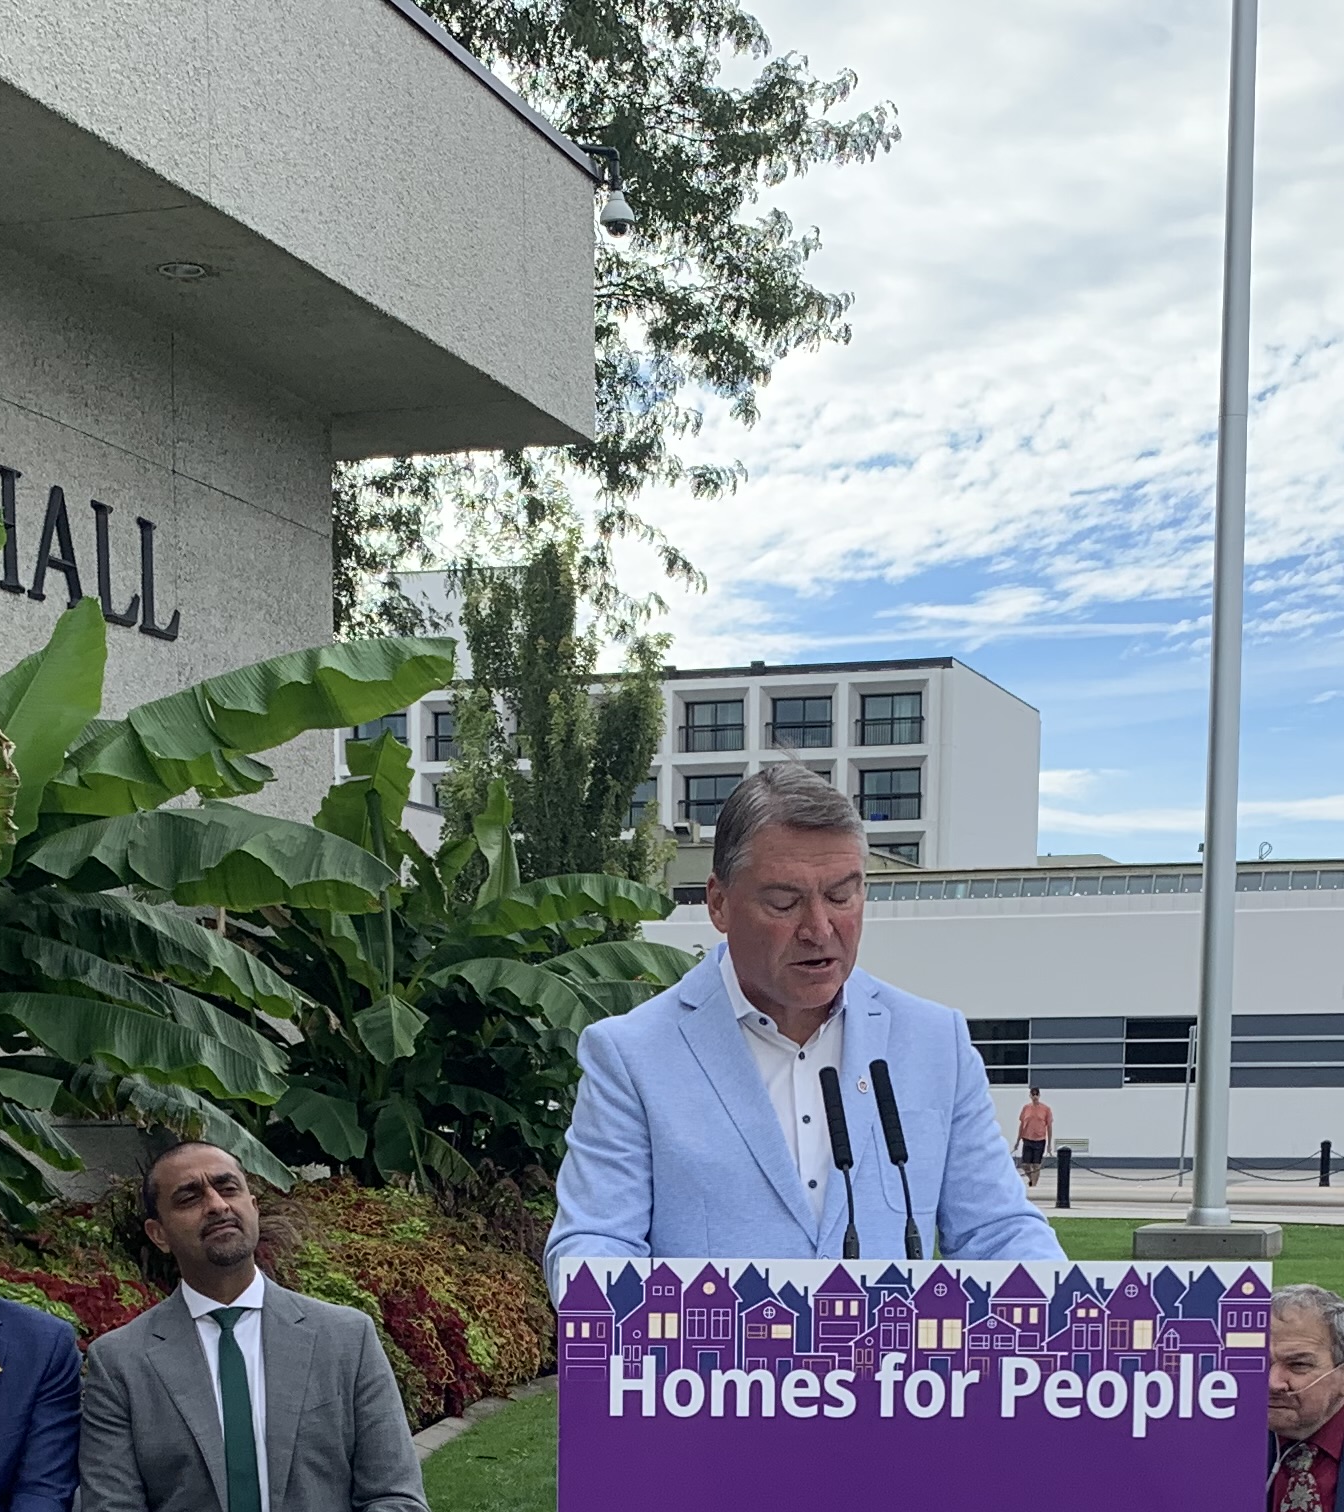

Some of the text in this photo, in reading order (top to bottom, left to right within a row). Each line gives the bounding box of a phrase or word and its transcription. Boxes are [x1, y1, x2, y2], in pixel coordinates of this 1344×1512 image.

[608, 1351, 1239, 1438] Homes for People
